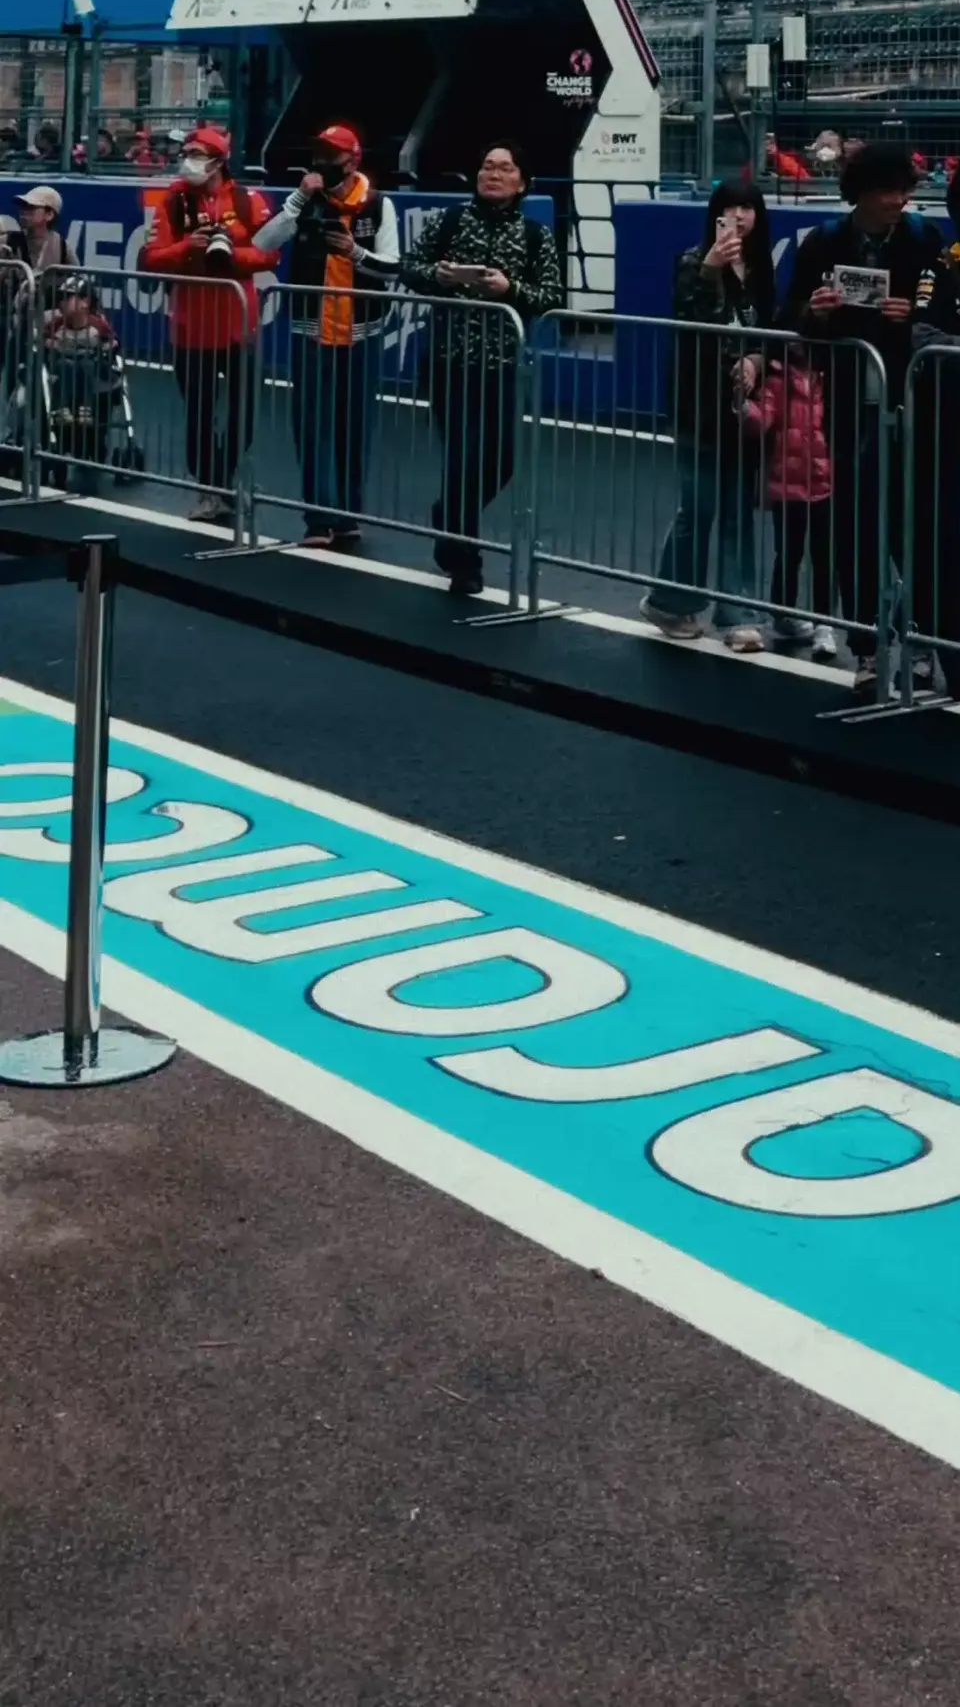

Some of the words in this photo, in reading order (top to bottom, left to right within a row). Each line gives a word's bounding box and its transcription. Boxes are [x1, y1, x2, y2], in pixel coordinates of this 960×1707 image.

[546, 76, 592, 87] CHANGE
[556, 87, 592, 96] WORLD
[612, 133, 637, 144] BWT
